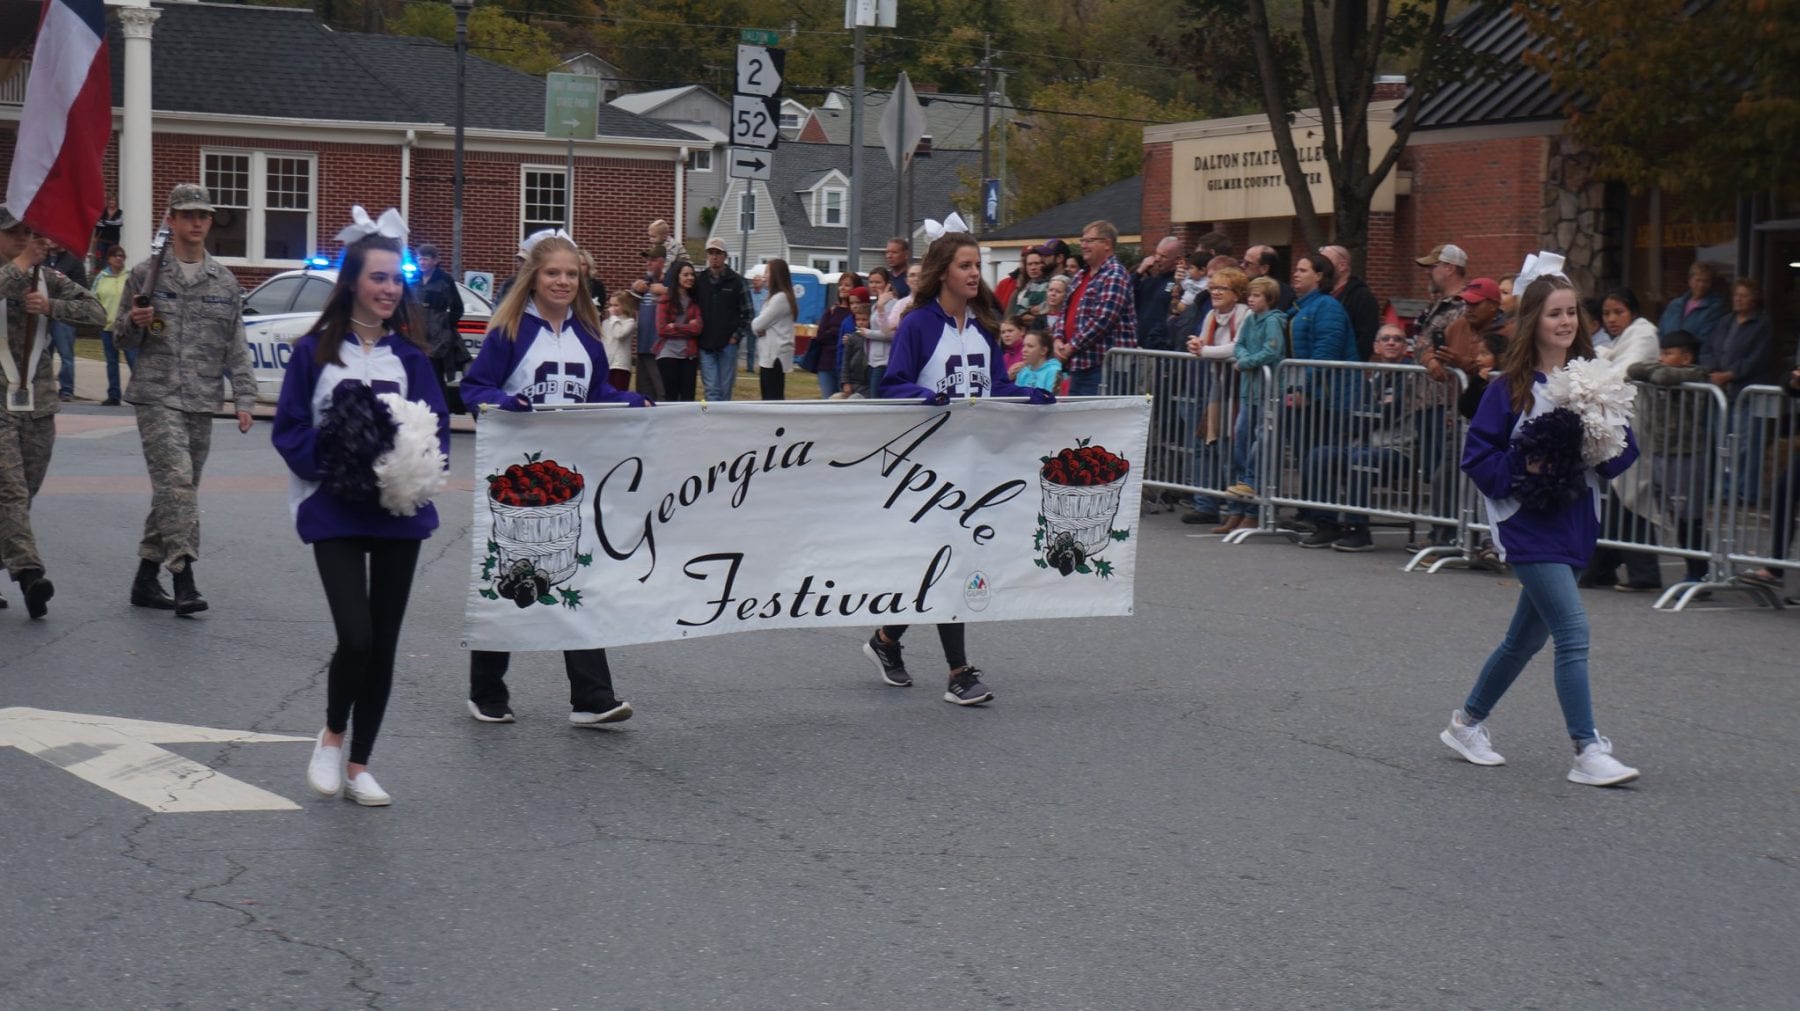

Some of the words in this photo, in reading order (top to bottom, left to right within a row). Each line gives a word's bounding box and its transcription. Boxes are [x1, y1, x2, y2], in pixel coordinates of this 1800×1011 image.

[748, 59, 762, 85] 2
[738, 110, 766, 138] 52
[1194, 153, 1239, 171] DALTON
[1242, 150, 1279, 167] STATE
[1208, 178, 1242, 191] GILMER
[1244, 175, 1282, 189] COUNTY
[247, 343, 292, 369] OLIC
[522, 380, 558, 399] BOB
[594, 427, 815, 583] Georgia
[828, 411, 1027, 545] Apple
[676, 545, 952, 626] Festival
